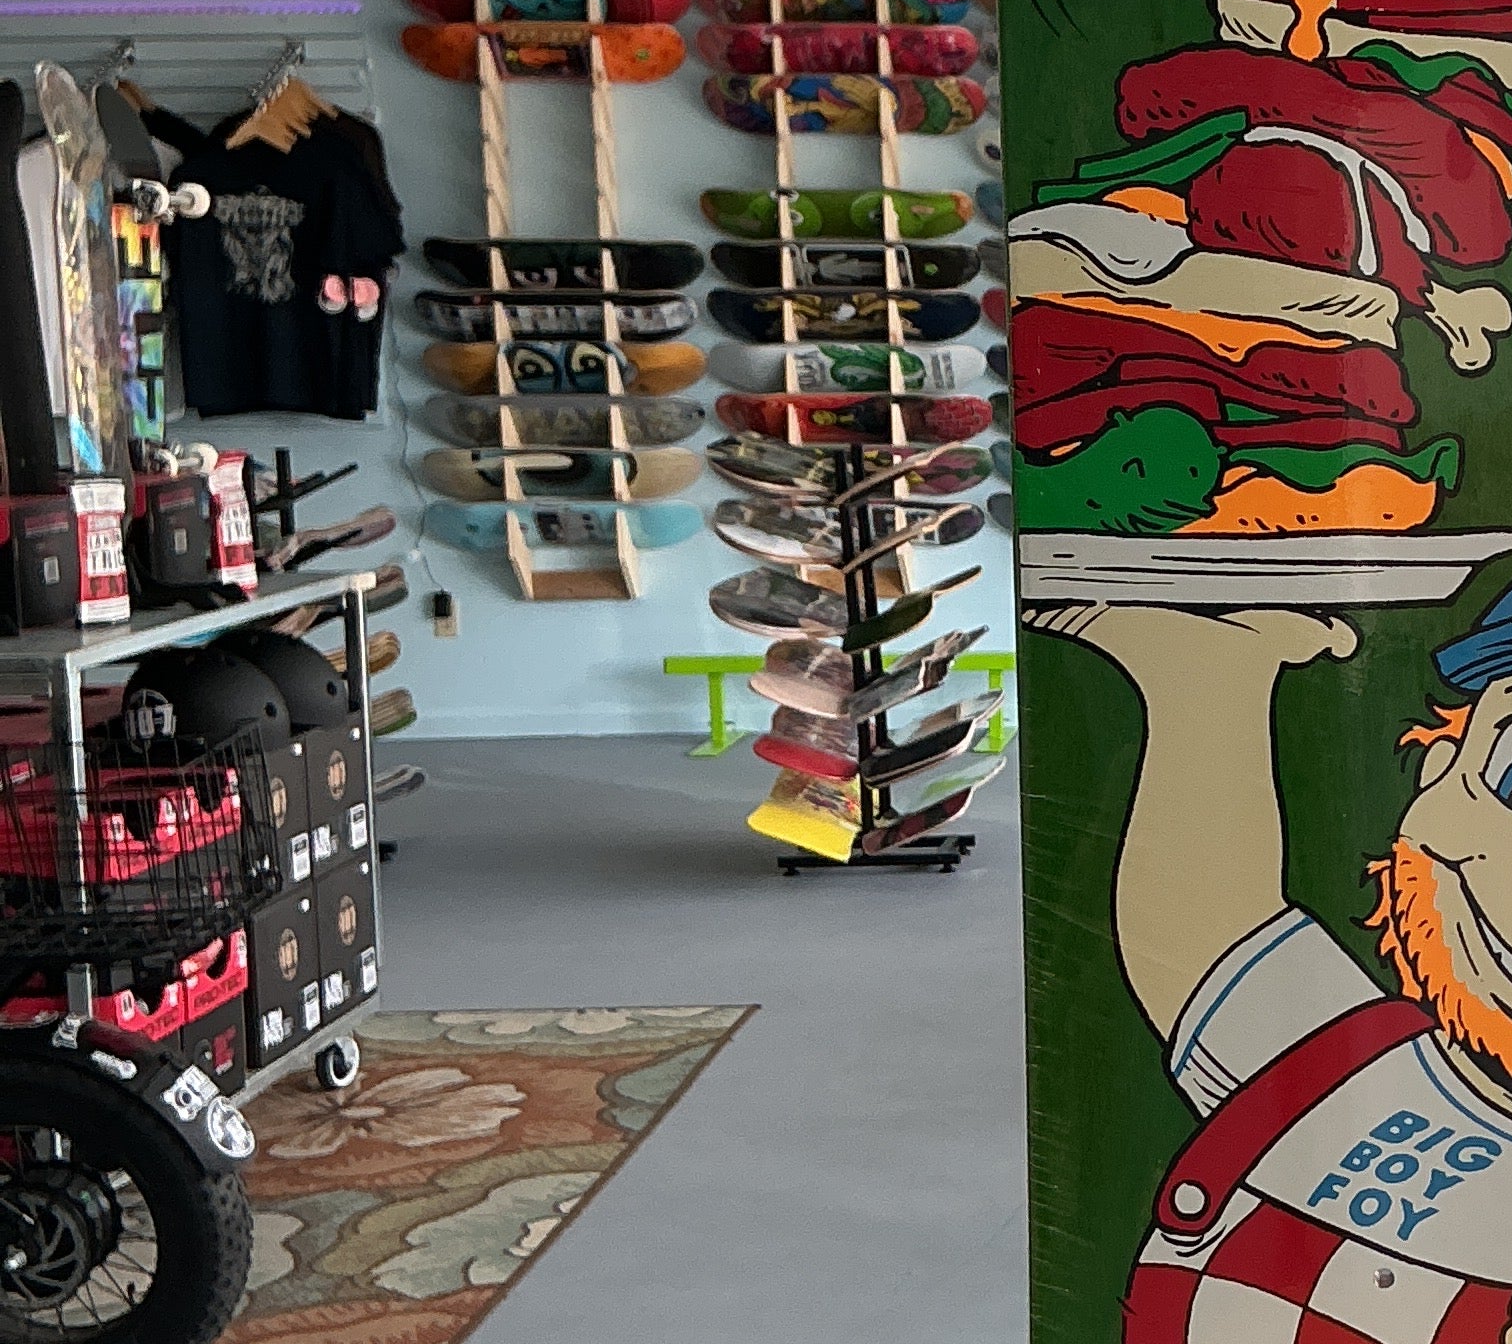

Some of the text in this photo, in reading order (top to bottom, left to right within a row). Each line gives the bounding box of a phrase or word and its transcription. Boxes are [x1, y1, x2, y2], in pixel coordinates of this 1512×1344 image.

[1339, 1139, 1466, 1201] BOY
[1368, 1109, 1503, 1173] BIG
[1306, 1172, 1440, 1242] FOY
